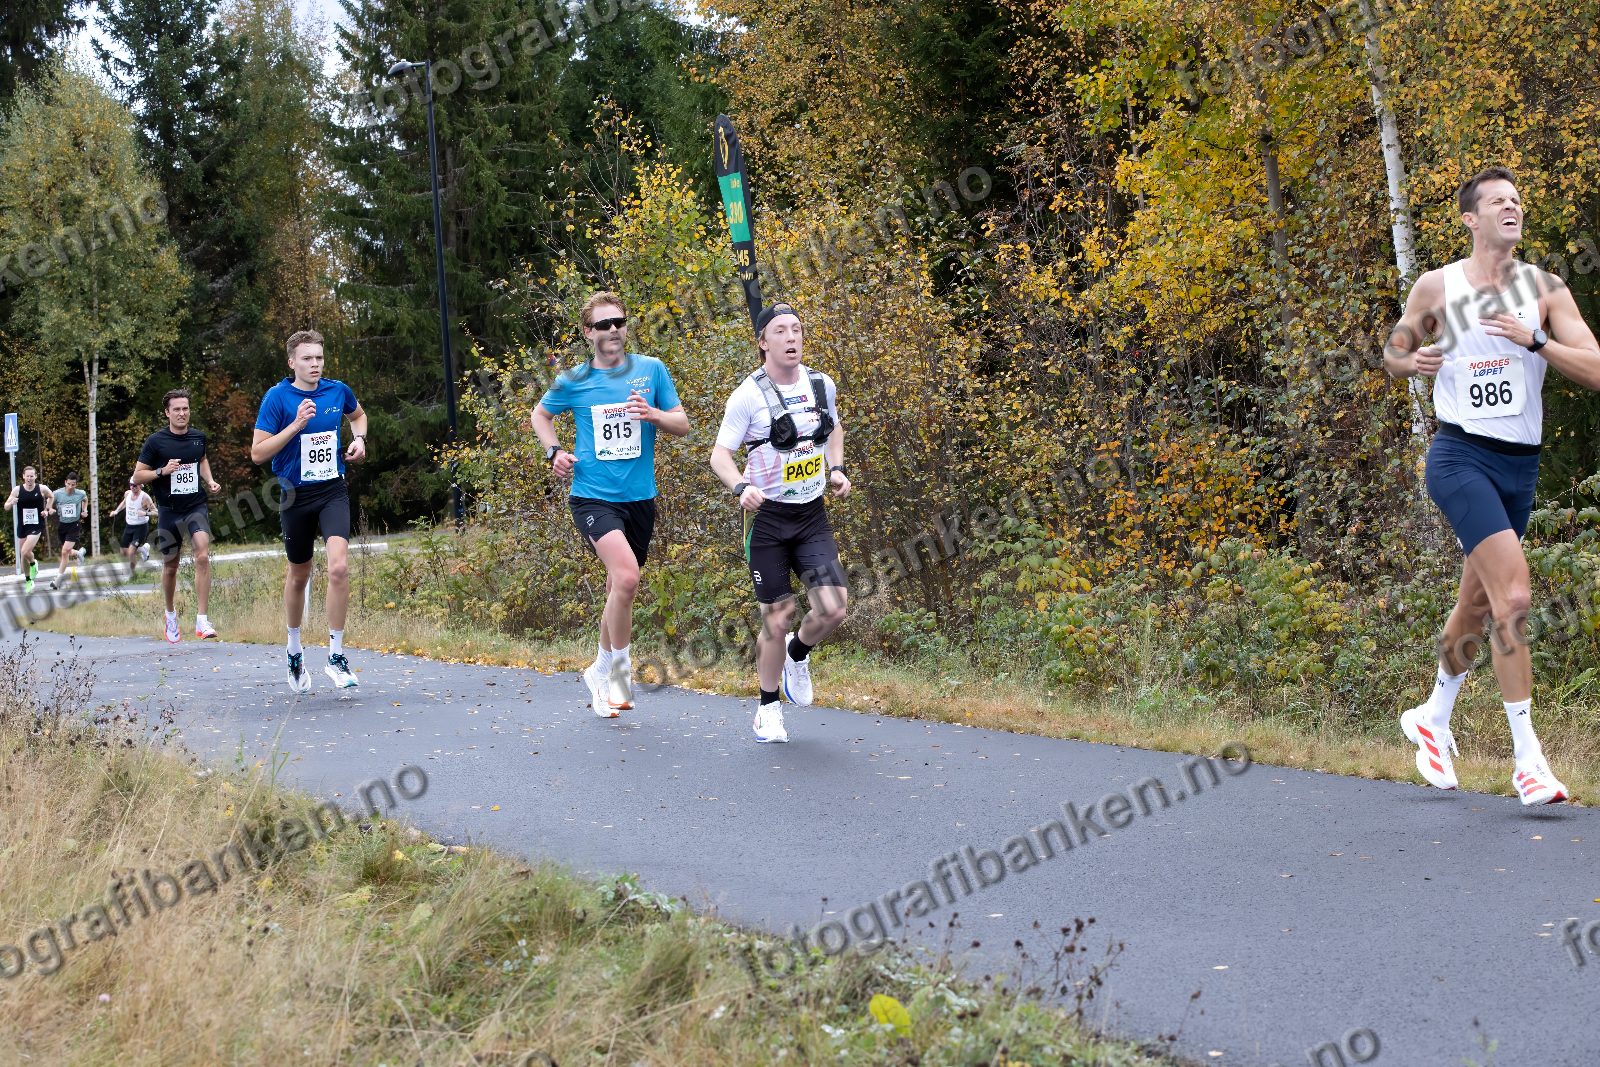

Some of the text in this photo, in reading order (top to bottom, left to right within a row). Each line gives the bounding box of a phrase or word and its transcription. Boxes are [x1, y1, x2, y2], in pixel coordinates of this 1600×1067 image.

[1468, 358, 1510, 370] NORGES
[1473, 366, 1504, 378] LØPET
[1469, 380, 1513, 408] 986
[602, 407, 627, 415] NORGE
[602, 421, 632, 441] 815
[308, 447, 332, 464] 965
[786, 457, 821, 481] PACE
[176, 472, 194, 484] 985
